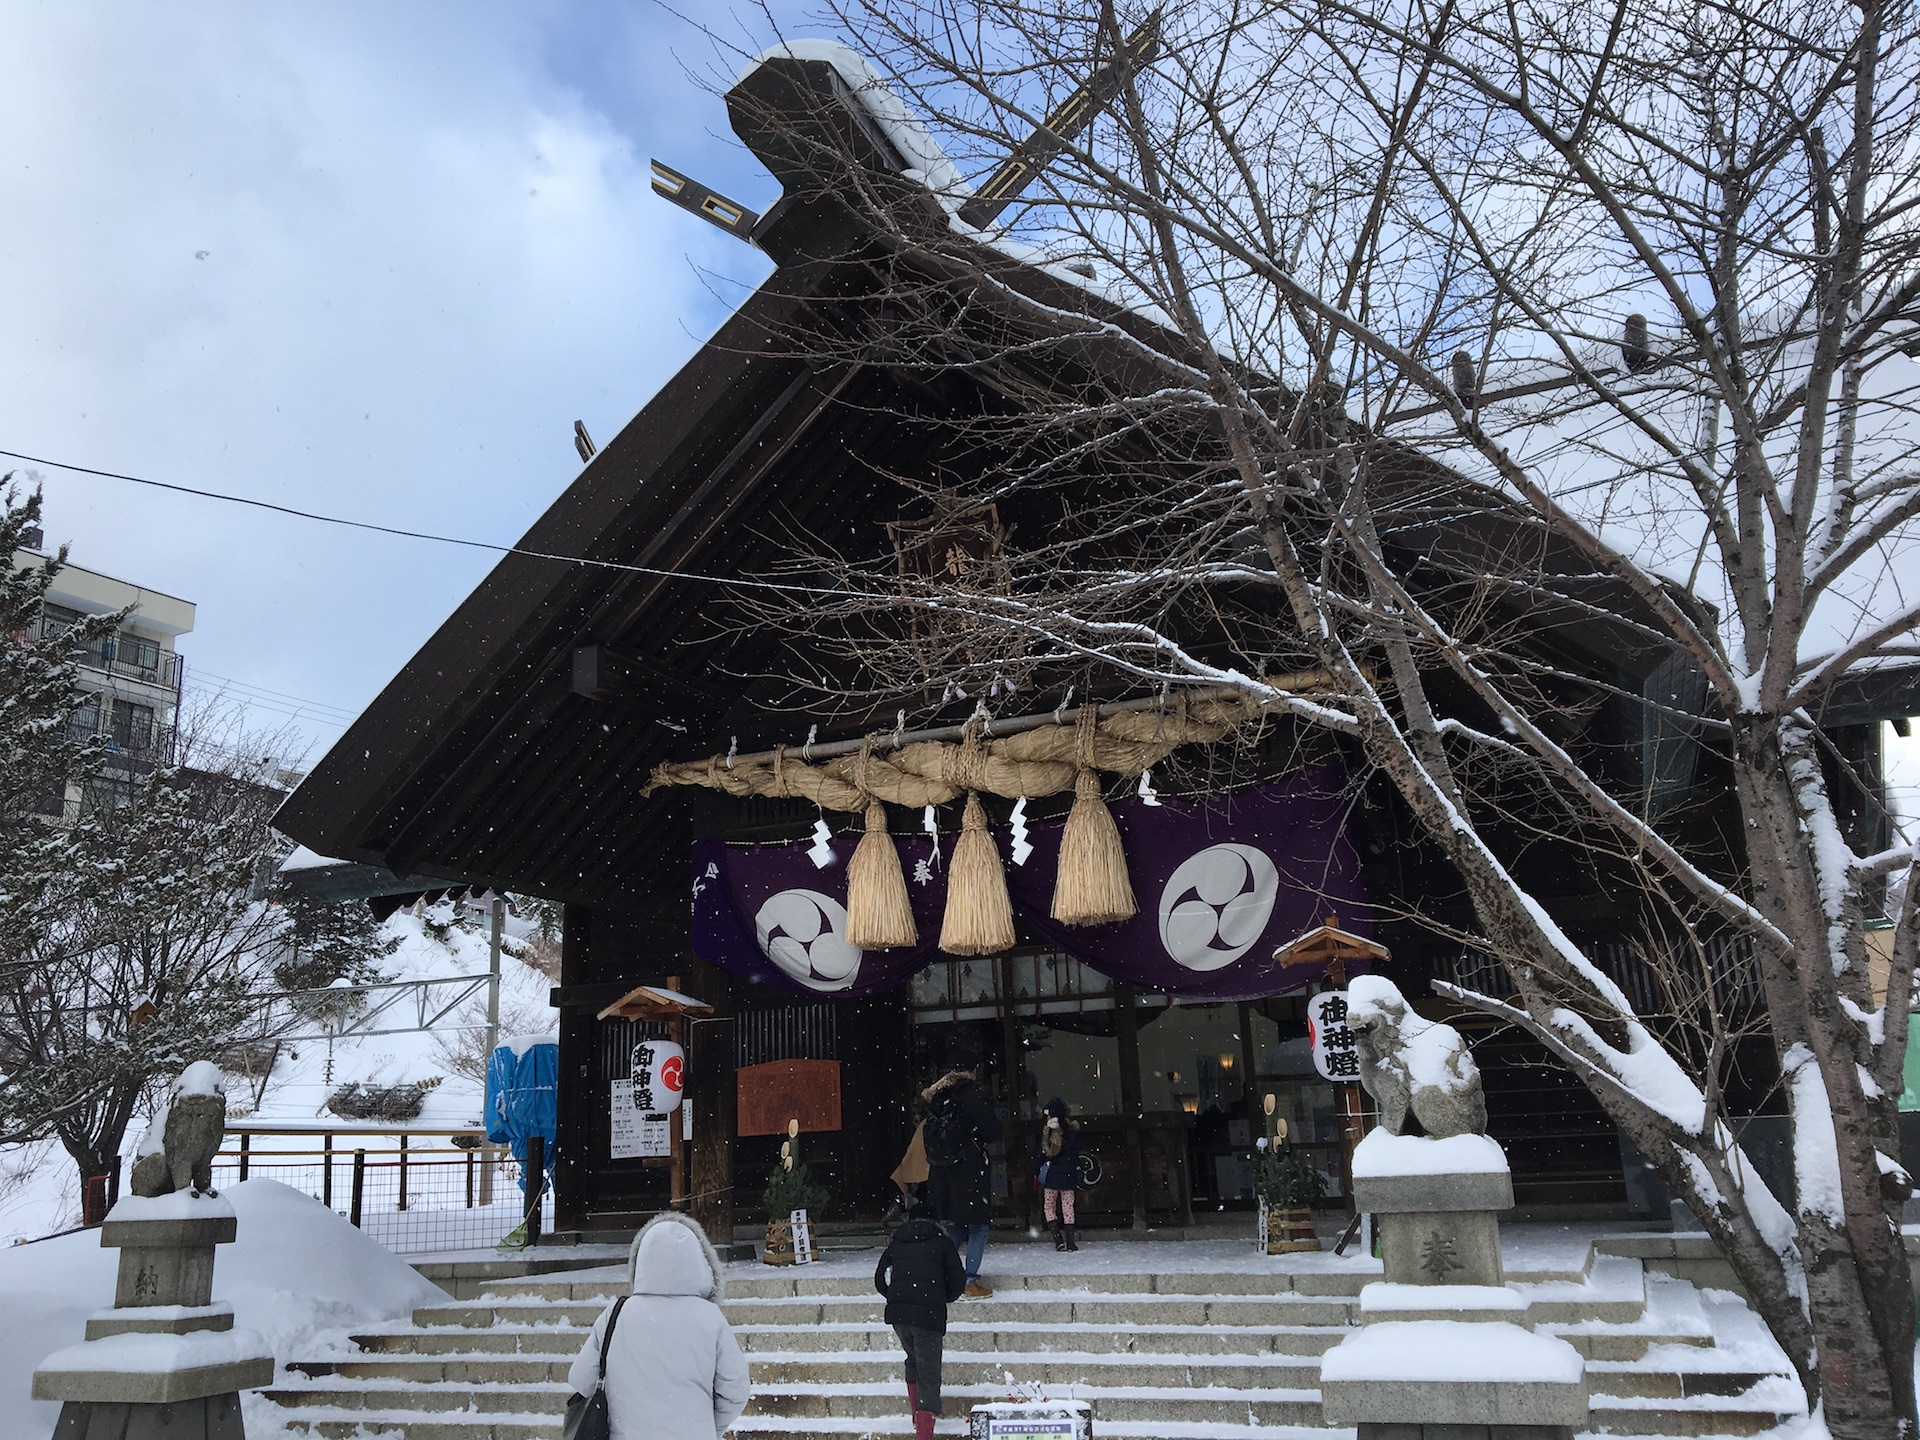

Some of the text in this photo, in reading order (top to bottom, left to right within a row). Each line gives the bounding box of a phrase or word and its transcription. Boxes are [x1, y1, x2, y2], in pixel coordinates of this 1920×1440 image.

[913, 859, 933, 886] 奉
[1319, 996, 1360, 1076] 御神燈
[632, 1044, 655, 1110] 御神燈
[135, 1264, 159, 1296] 納
[1419, 1231, 1466, 1282] 奉
